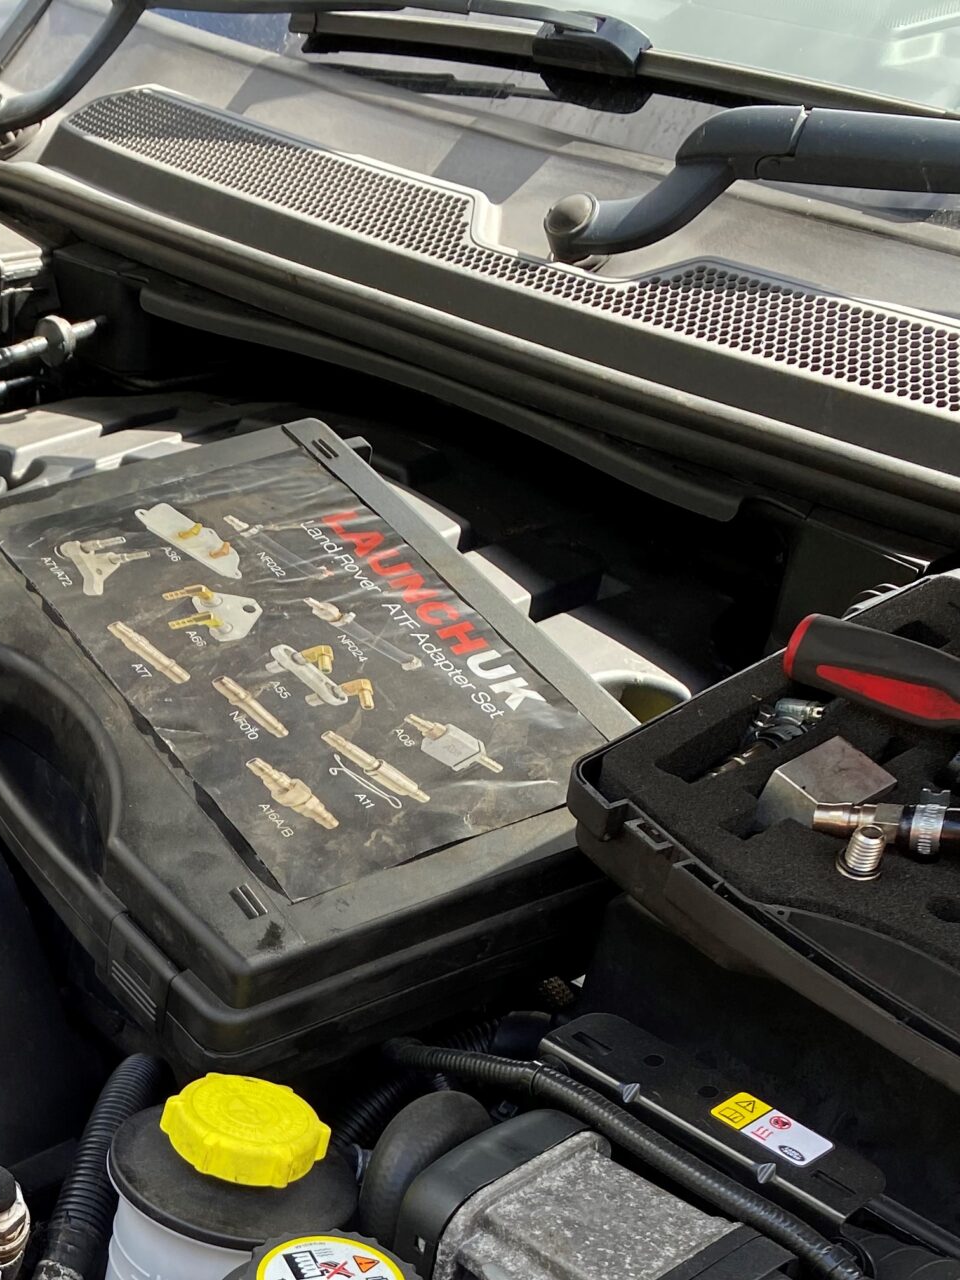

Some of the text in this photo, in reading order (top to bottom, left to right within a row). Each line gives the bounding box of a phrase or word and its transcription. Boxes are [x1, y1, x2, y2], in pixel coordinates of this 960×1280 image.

[162, 546, 182, 563] A36
[256, 551, 286, 578] NF022
[300, 519, 506, 720] Land Rover ATF Adapter Set
[337, 634, 369, 663] NF024
[131, 663, 153, 679] A77
[269, 680, 292, 700] A55
[392, 727, 416, 748] A08
[354, 793, 376, 810] A11
[258, 803, 294, 838] A16A/B
